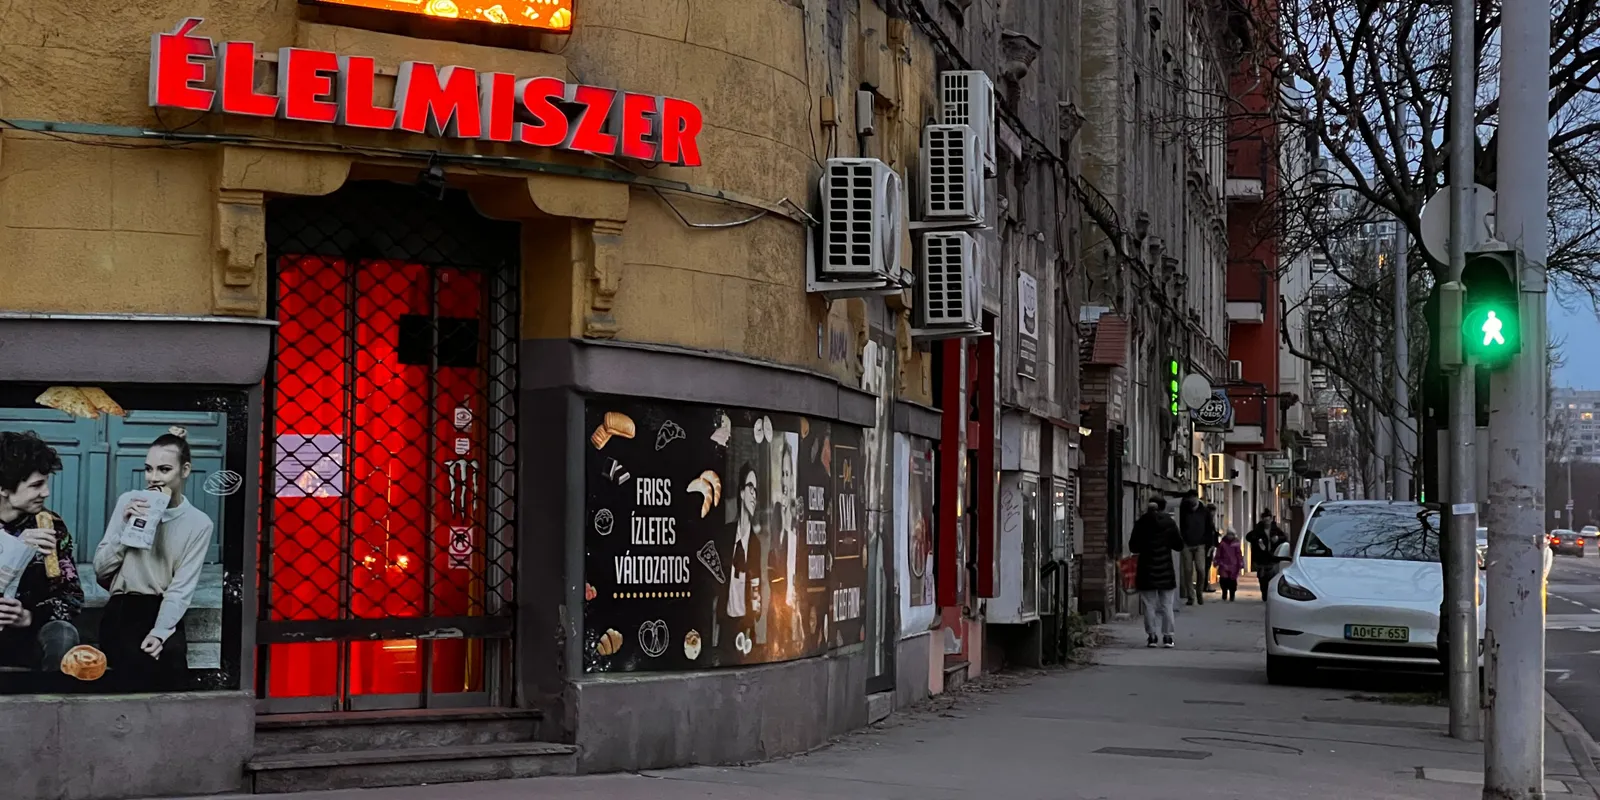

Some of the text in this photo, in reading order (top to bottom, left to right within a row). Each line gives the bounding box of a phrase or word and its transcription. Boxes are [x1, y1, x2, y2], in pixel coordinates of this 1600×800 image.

[150, 17, 703, 168] ÉLELMISZER
[636, 477, 672, 506] FRISS
[631, 510, 677, 545] ÍZLETES
[614, 549, 691, 585] VÁLTOZATOS
